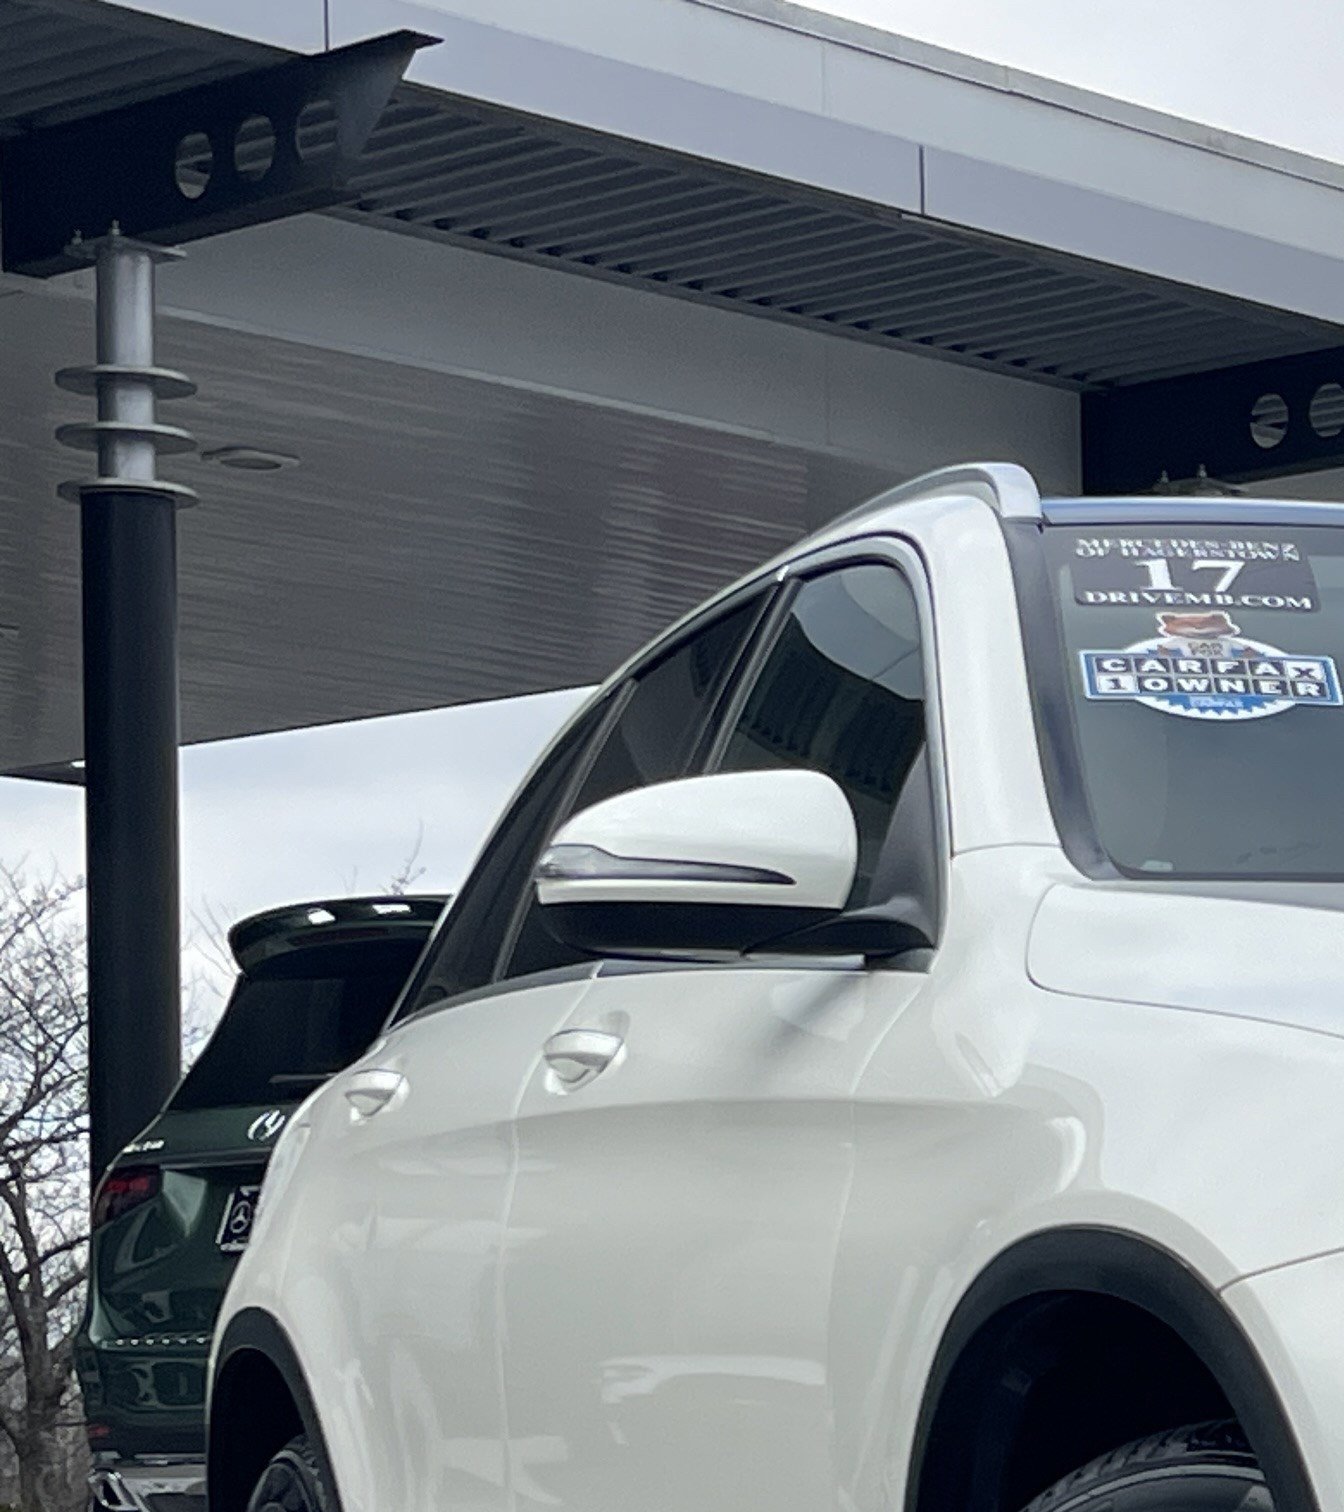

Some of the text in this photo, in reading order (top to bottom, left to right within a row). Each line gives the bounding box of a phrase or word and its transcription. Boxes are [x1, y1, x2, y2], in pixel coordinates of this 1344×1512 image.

[1076, 547, 1301, 562] OF HAGERSTOWN
[1077, 537, 1298, 553] MERCEDES-BENZ
[1134, 558, 1246, 593] 17
[1084, 591, 1314, 611] DRIVEMB.COM
[1099, 657, 1319, 682] CARFAX
[1143, 676, 1322, 698] OWNER
